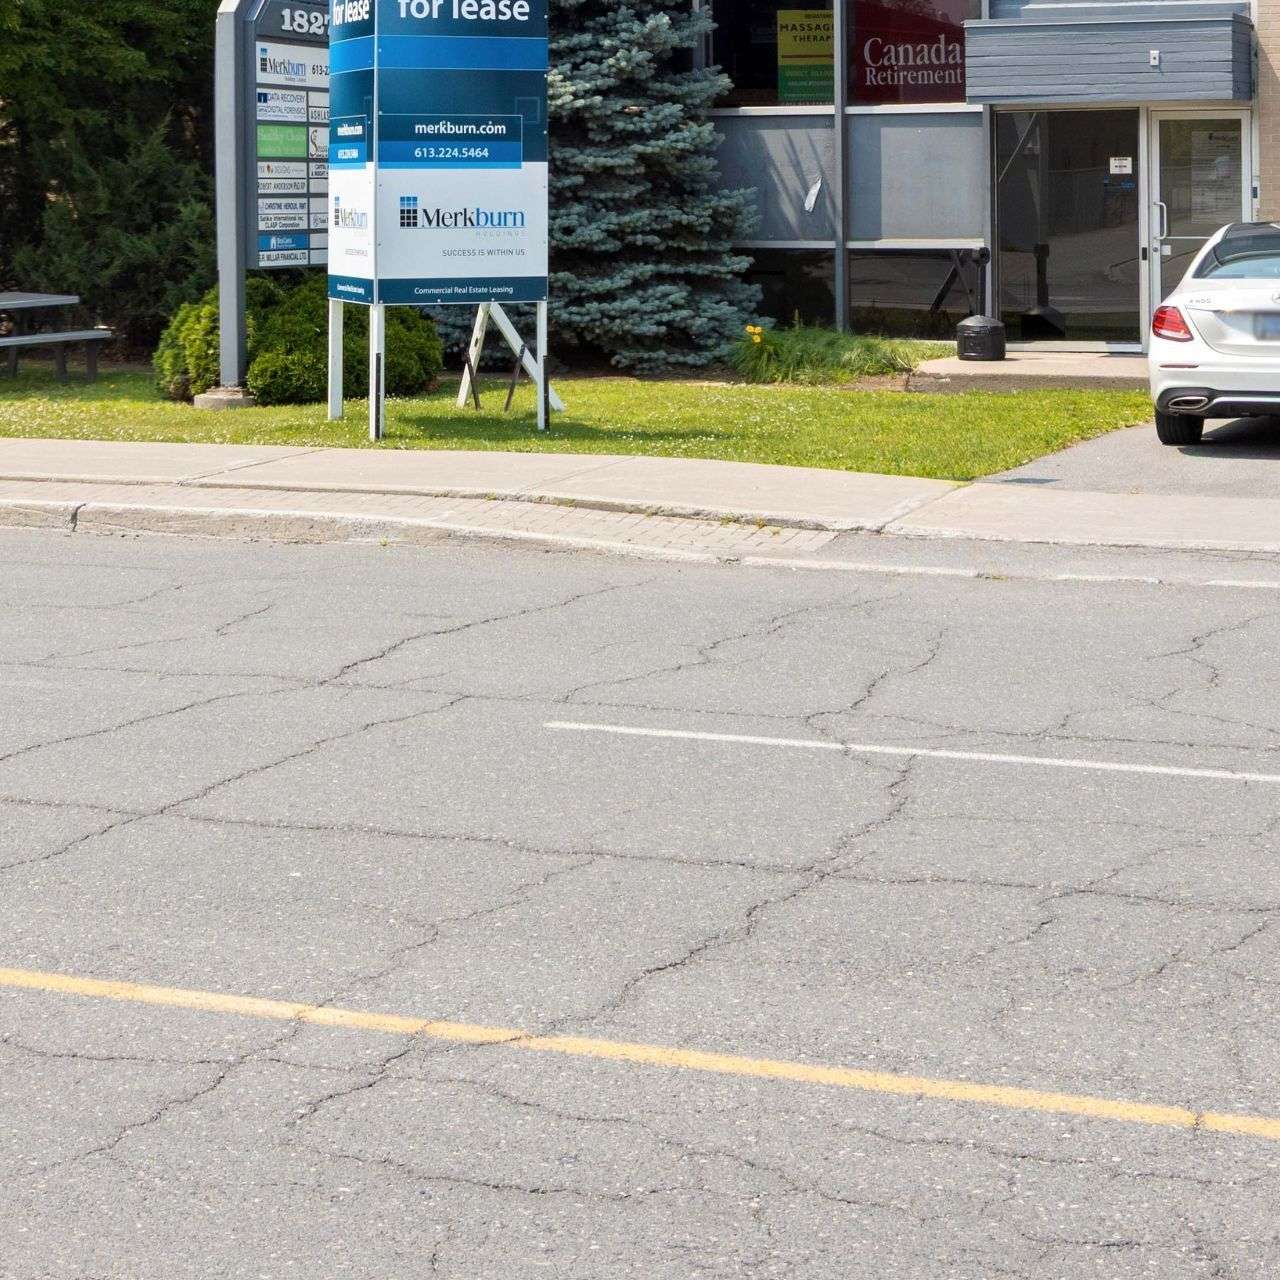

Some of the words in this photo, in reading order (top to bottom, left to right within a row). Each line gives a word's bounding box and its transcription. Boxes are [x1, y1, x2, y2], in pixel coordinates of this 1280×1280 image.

[780, 23, 834, 32] MASSAG
[863, 33, 962, 67] Canada
[865, 66, 962, 86] Retirement
[414, 121, 507, 135] merkburn.com
[414, 147, 489, 158] 613.224.5464
[422, 208, 525, 228] Merkburn
[442, 249, 477, 257] SUCCESS
[478, 248, 485, 256] IS
[486, 248, 514, 256] WITHIN
[515, 248, 526, 256] US
[414, 287, 453, 295] Commercial
[454, 286, 468, 294] Real
[468, 286, 488, 294] Estate
[489, 286, 514, 295] Leasing
